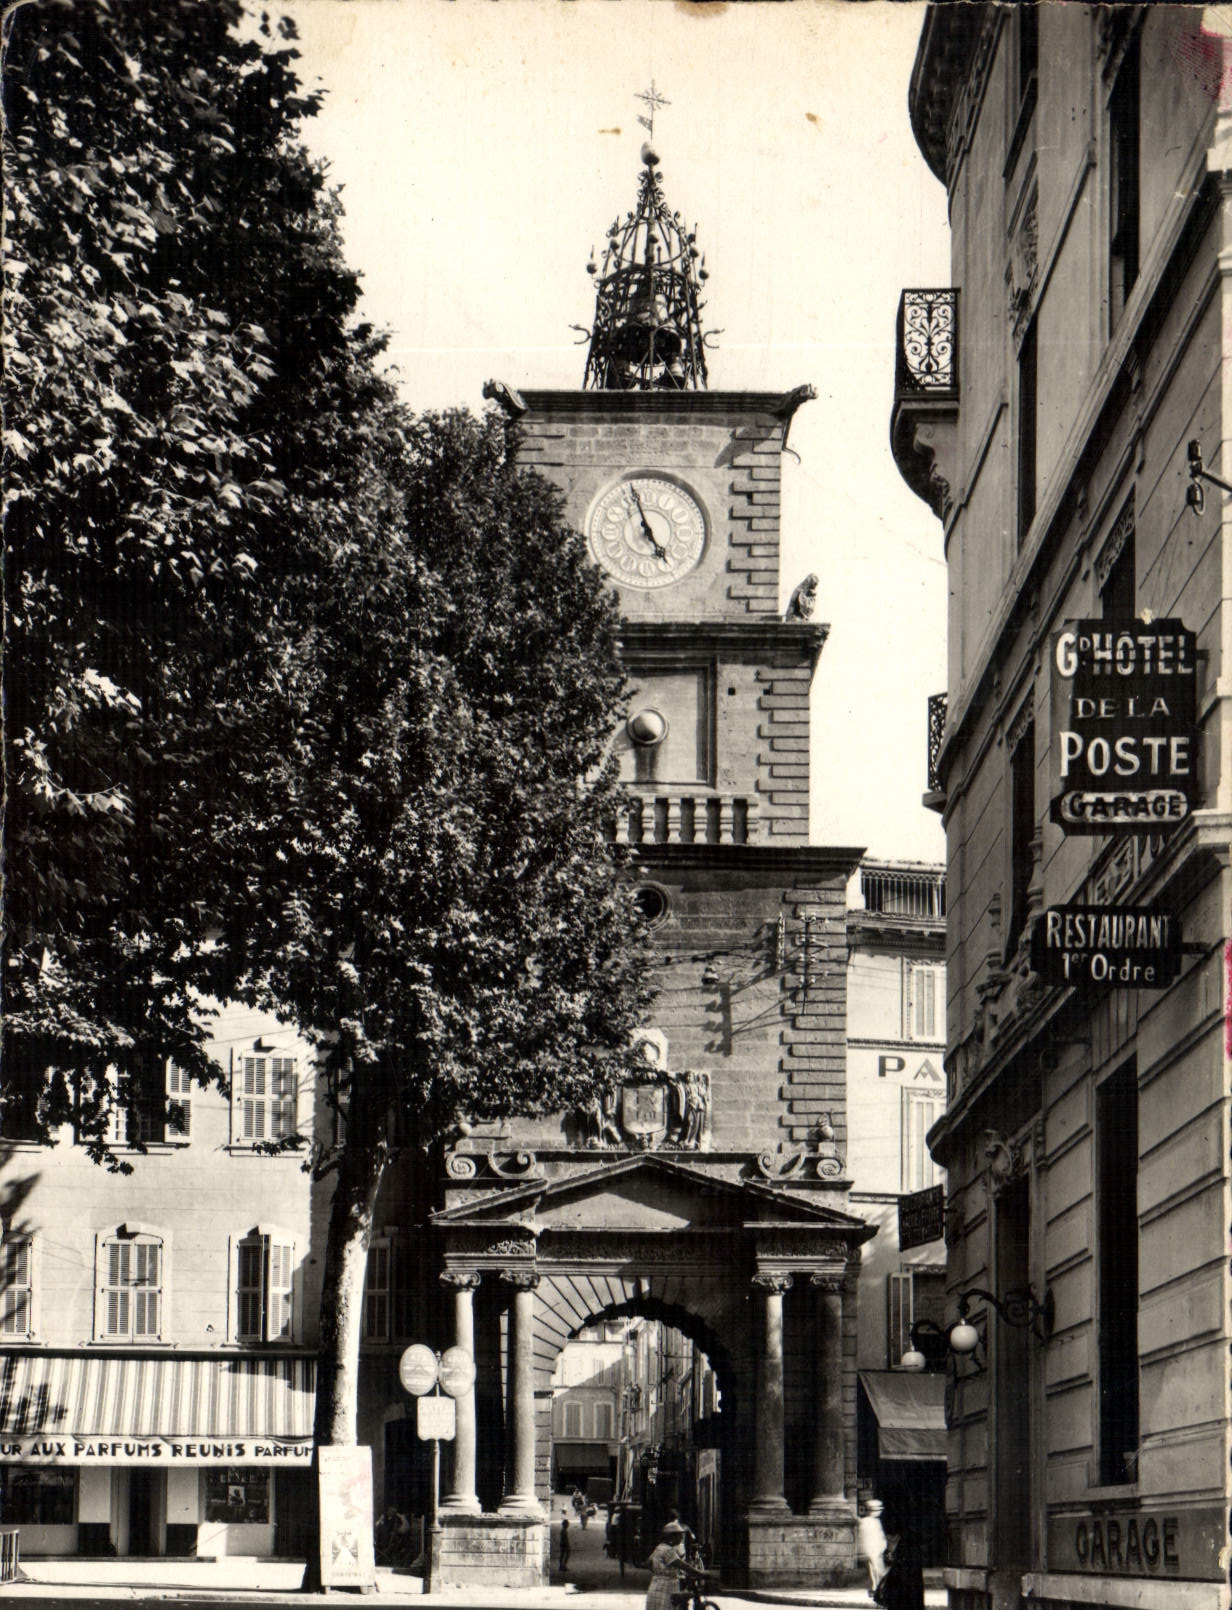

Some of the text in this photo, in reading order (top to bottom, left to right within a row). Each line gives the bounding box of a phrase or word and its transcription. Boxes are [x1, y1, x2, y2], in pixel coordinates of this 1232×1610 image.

[1075, 696, 1170, 719] DE LA
[1059, 731, 1190, 777] POSTE
[1069, 793, 1181, 817] GARAGE
[1046, 911, 1170, 949] RESTAURANT
[1062, 952, 1155, 981] 1er Ordre
[30, 1442, 66, 1456] AUX
[74, 1443, 162, 1457] PARFUMS
[1075, 1517, 1180, 1571] GARAGE
